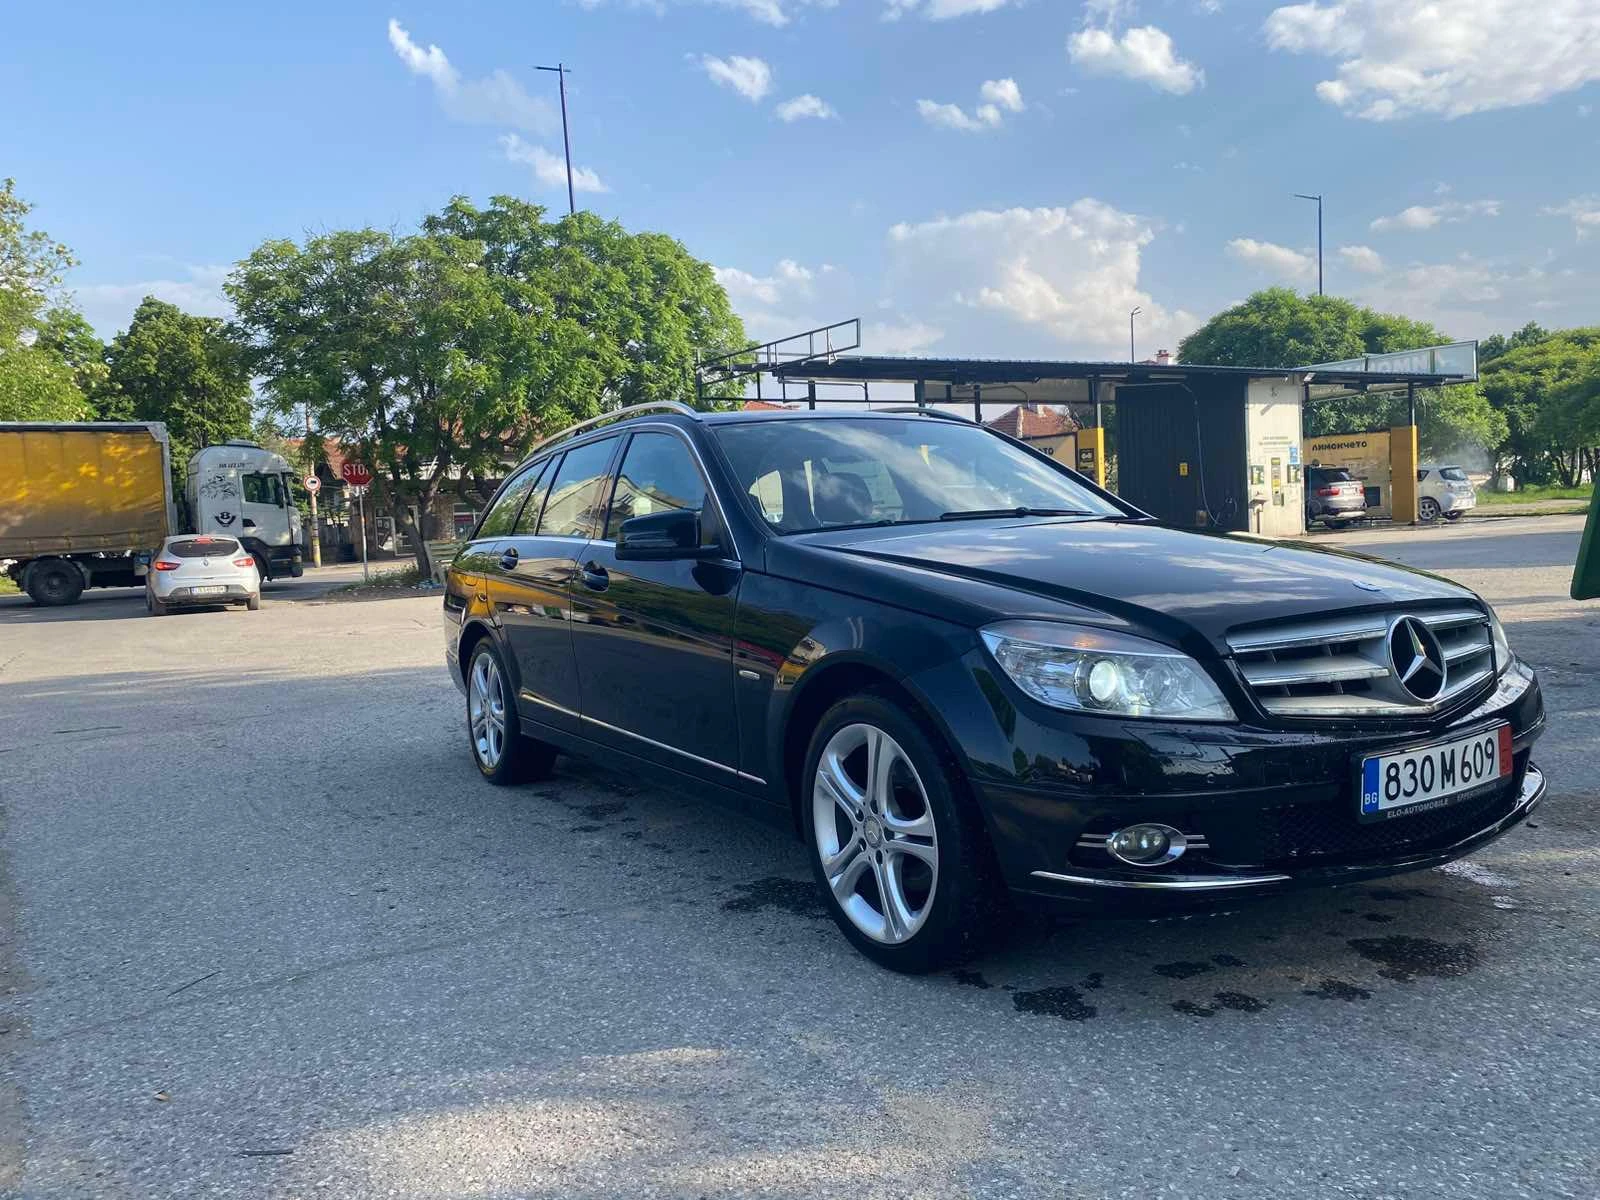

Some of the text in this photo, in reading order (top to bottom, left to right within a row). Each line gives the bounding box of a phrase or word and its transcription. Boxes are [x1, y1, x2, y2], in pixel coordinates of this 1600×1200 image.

[1384, 754, 1435, 801] 830
[1441, 747, 1456, 790] M
[1460, 737, 1496, 783] 609
[1364, 792, 1378, 805] BG
[1387, 797, 1449, 819] ELO-AUTOMOBILE
